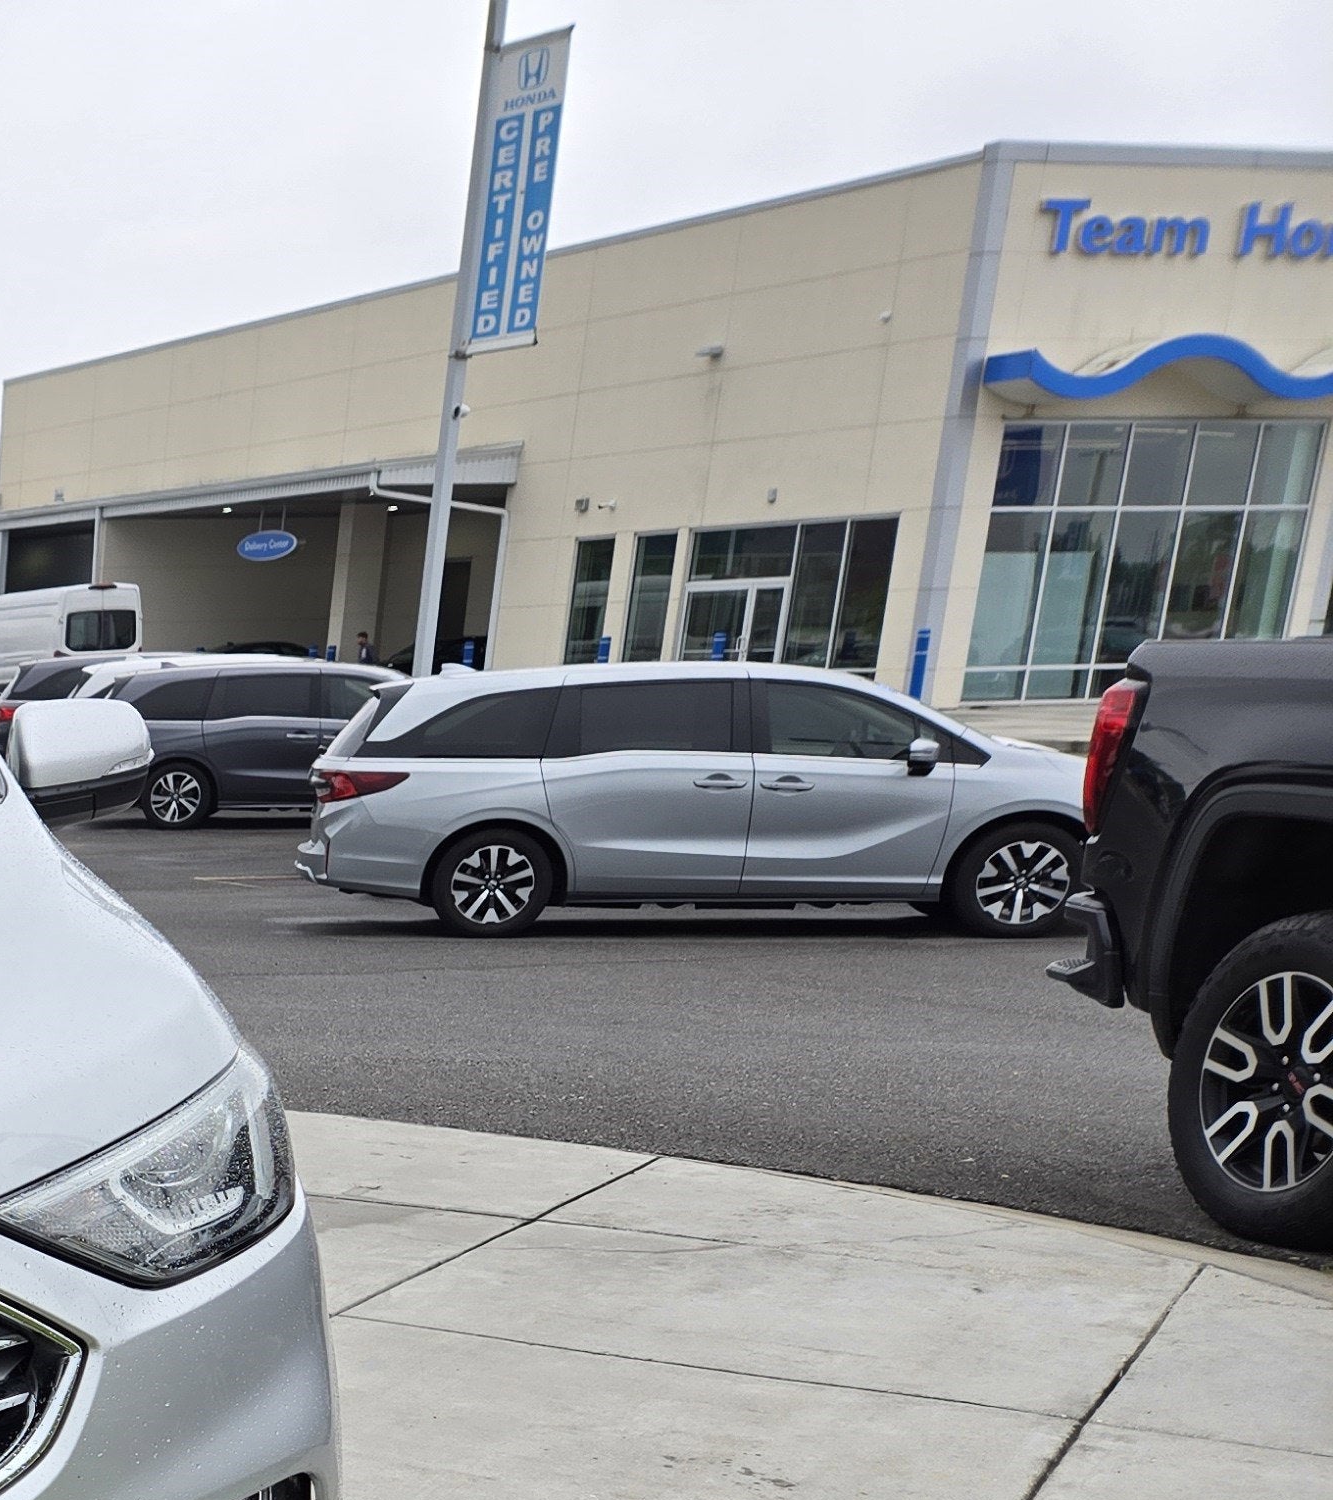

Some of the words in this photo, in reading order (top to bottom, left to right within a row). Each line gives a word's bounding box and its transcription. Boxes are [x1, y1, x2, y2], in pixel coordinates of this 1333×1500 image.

[503, 87, 557, 111] HONDA
[533, 110, 554, 183] PRE
[475, 119, 520, 335] CERTIFIED
[1041, 198, 1211, 257] Team
[1237, 200, 1333, 260] Ho
[513, 209, 545, 329] OWNED
